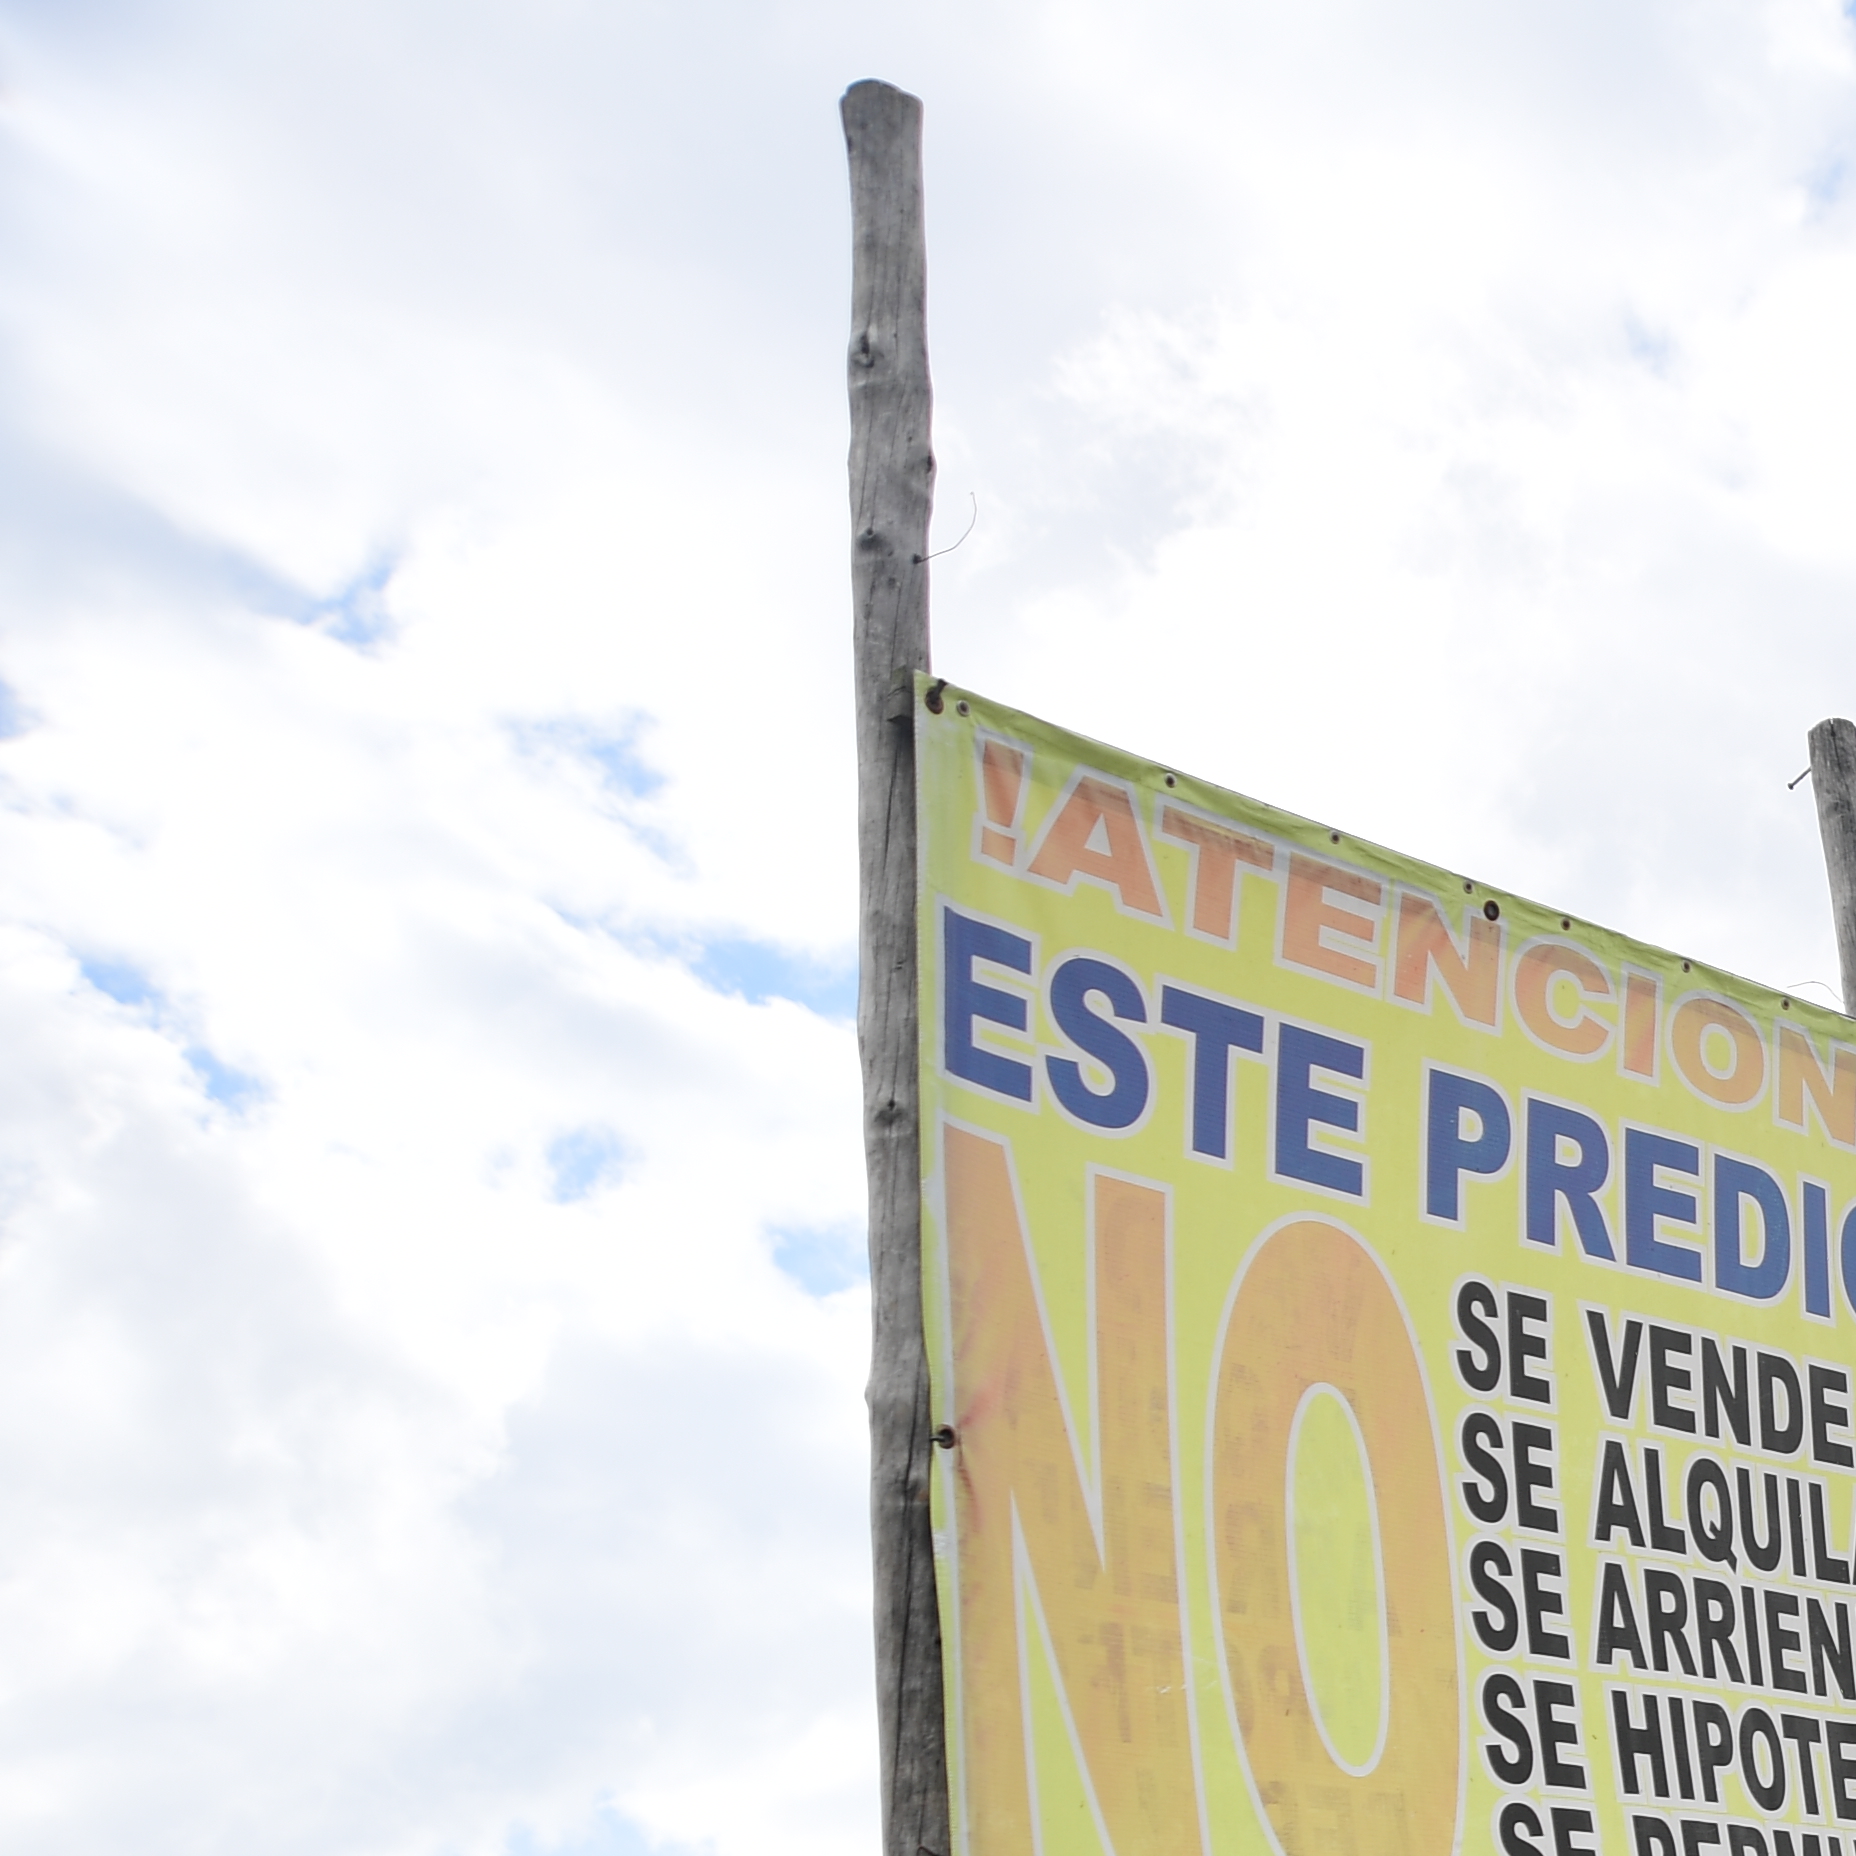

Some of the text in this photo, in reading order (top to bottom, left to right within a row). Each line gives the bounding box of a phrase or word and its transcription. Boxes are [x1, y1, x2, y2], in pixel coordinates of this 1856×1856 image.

[944, 904, 1364, 1197] ESTE
[1456, 1281, 1854, 1468] SE VENDE
[1462, 1413, 1559, 1533] SE
[1470, 1541, 1571, 1660] SE
[1482, 1674, 1586, 1789] SE
